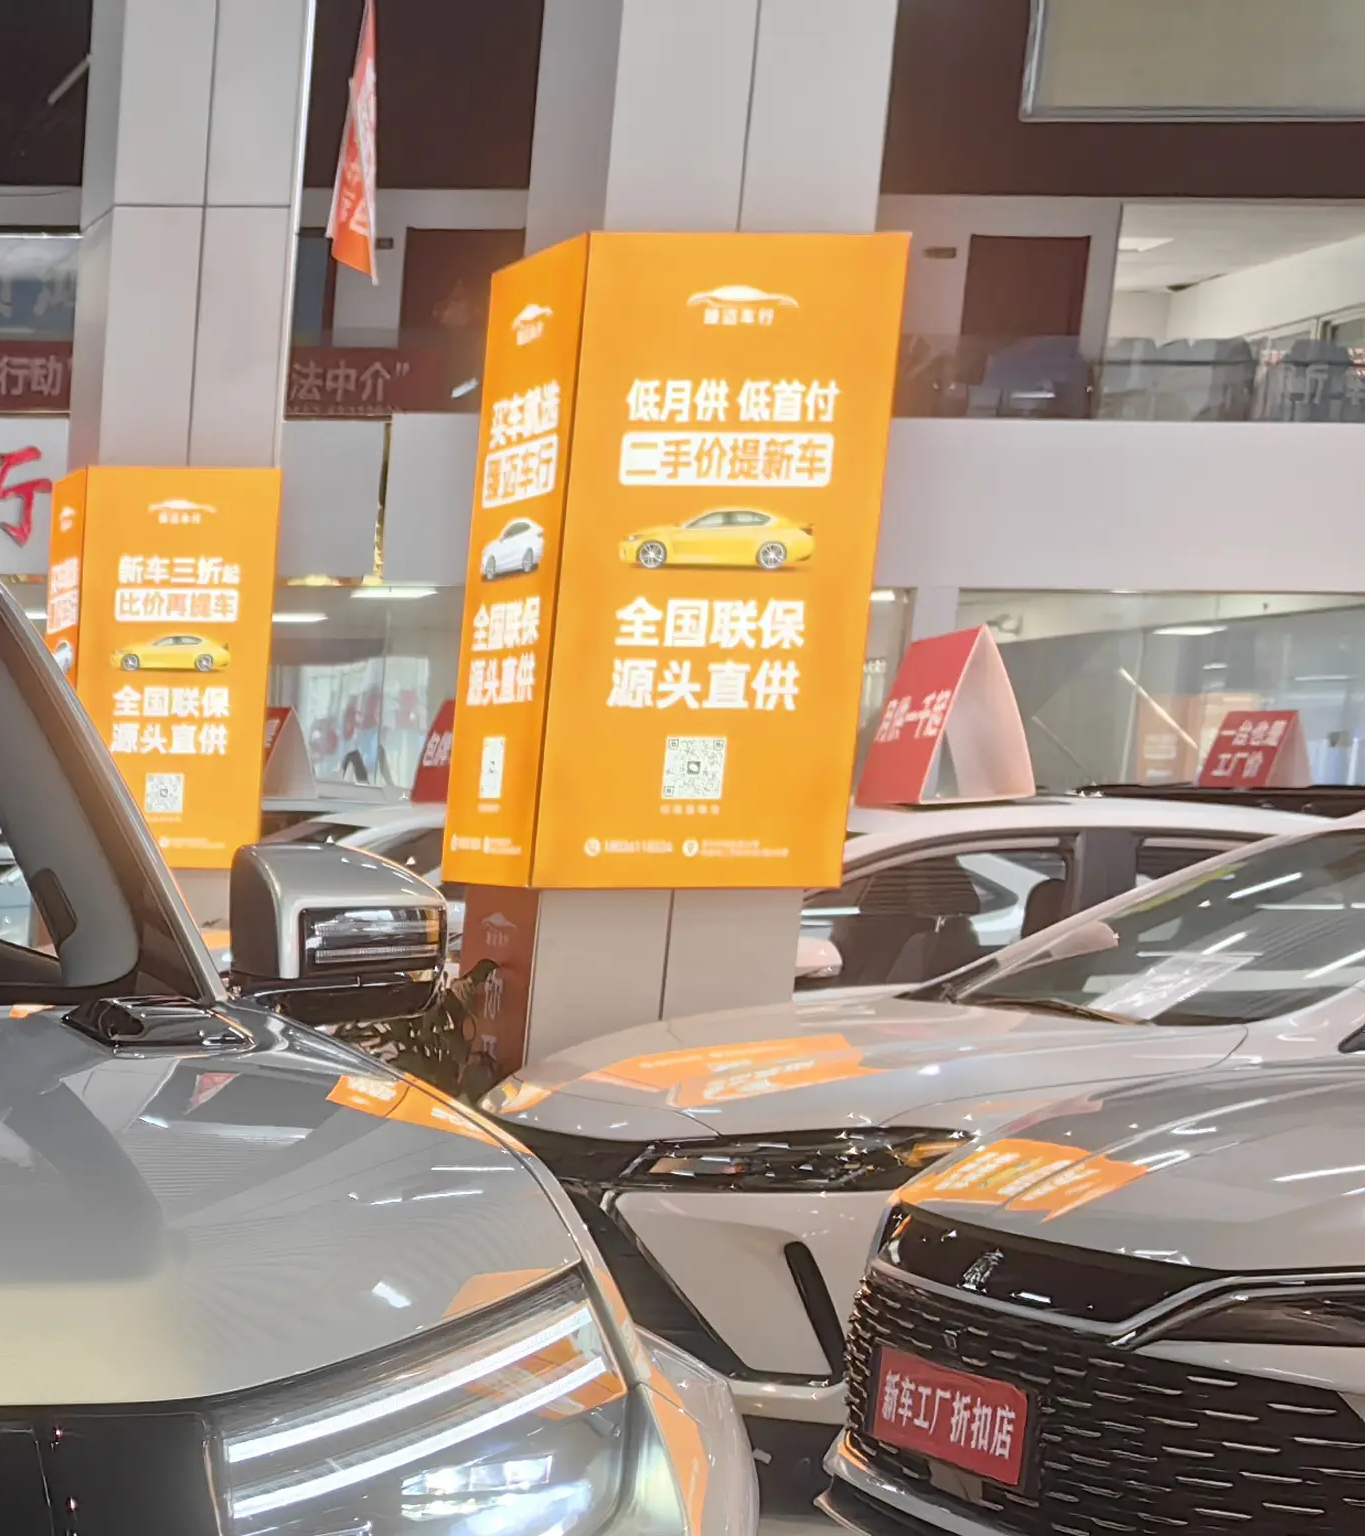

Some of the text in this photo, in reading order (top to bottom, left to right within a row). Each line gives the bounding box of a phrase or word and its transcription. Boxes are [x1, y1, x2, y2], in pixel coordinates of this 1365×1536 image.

[626, 379, 841, 423] 低月供 低首付
[625, 437, 829, 481] 二手价提新车
[614, 595, 806, 651] 全国联保
[112, 685, 231, 718] 全国联保
[606, 658, 802, 712] 源头直供
[110, 722, 228, 756] 源头直供
[881, 1371, 1017, 1460] 新车工厂折扣店
